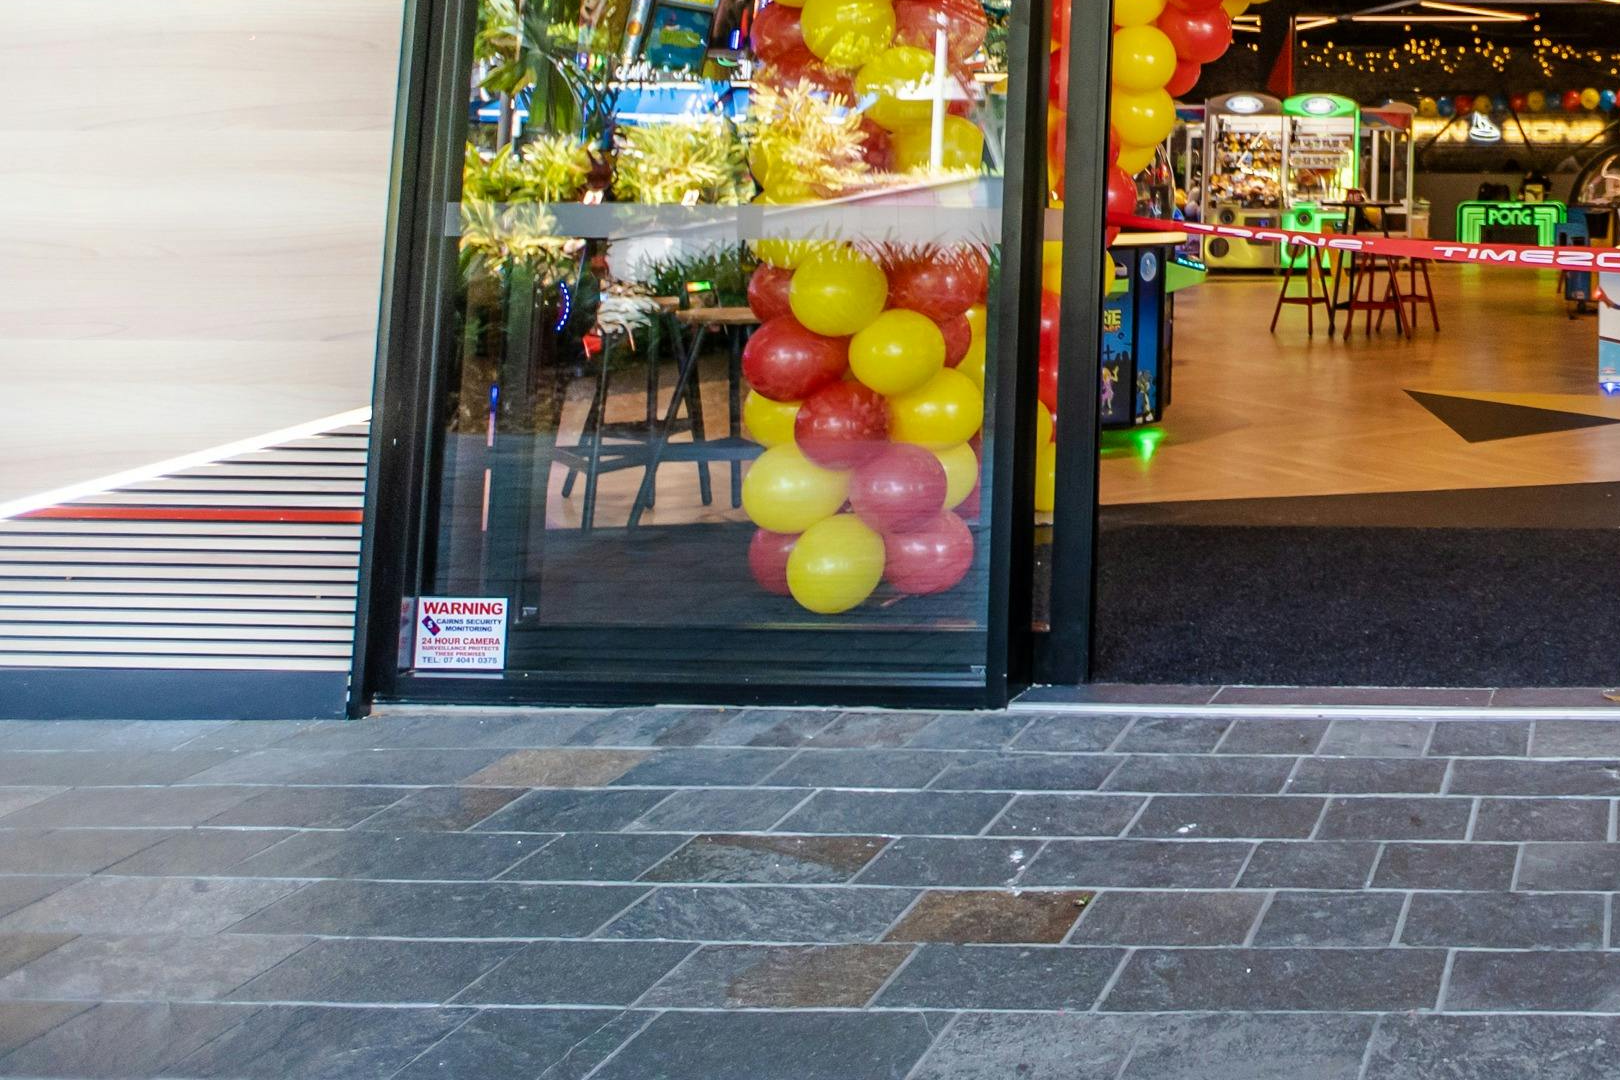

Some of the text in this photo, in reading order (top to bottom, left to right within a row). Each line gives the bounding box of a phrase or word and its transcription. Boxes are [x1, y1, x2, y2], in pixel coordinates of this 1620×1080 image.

[1488, 209, 1532, 226] PONG
[423, 602, 503, 615] WARNING
[422, 637, 500, 645] 24 HOUR CAMERA
